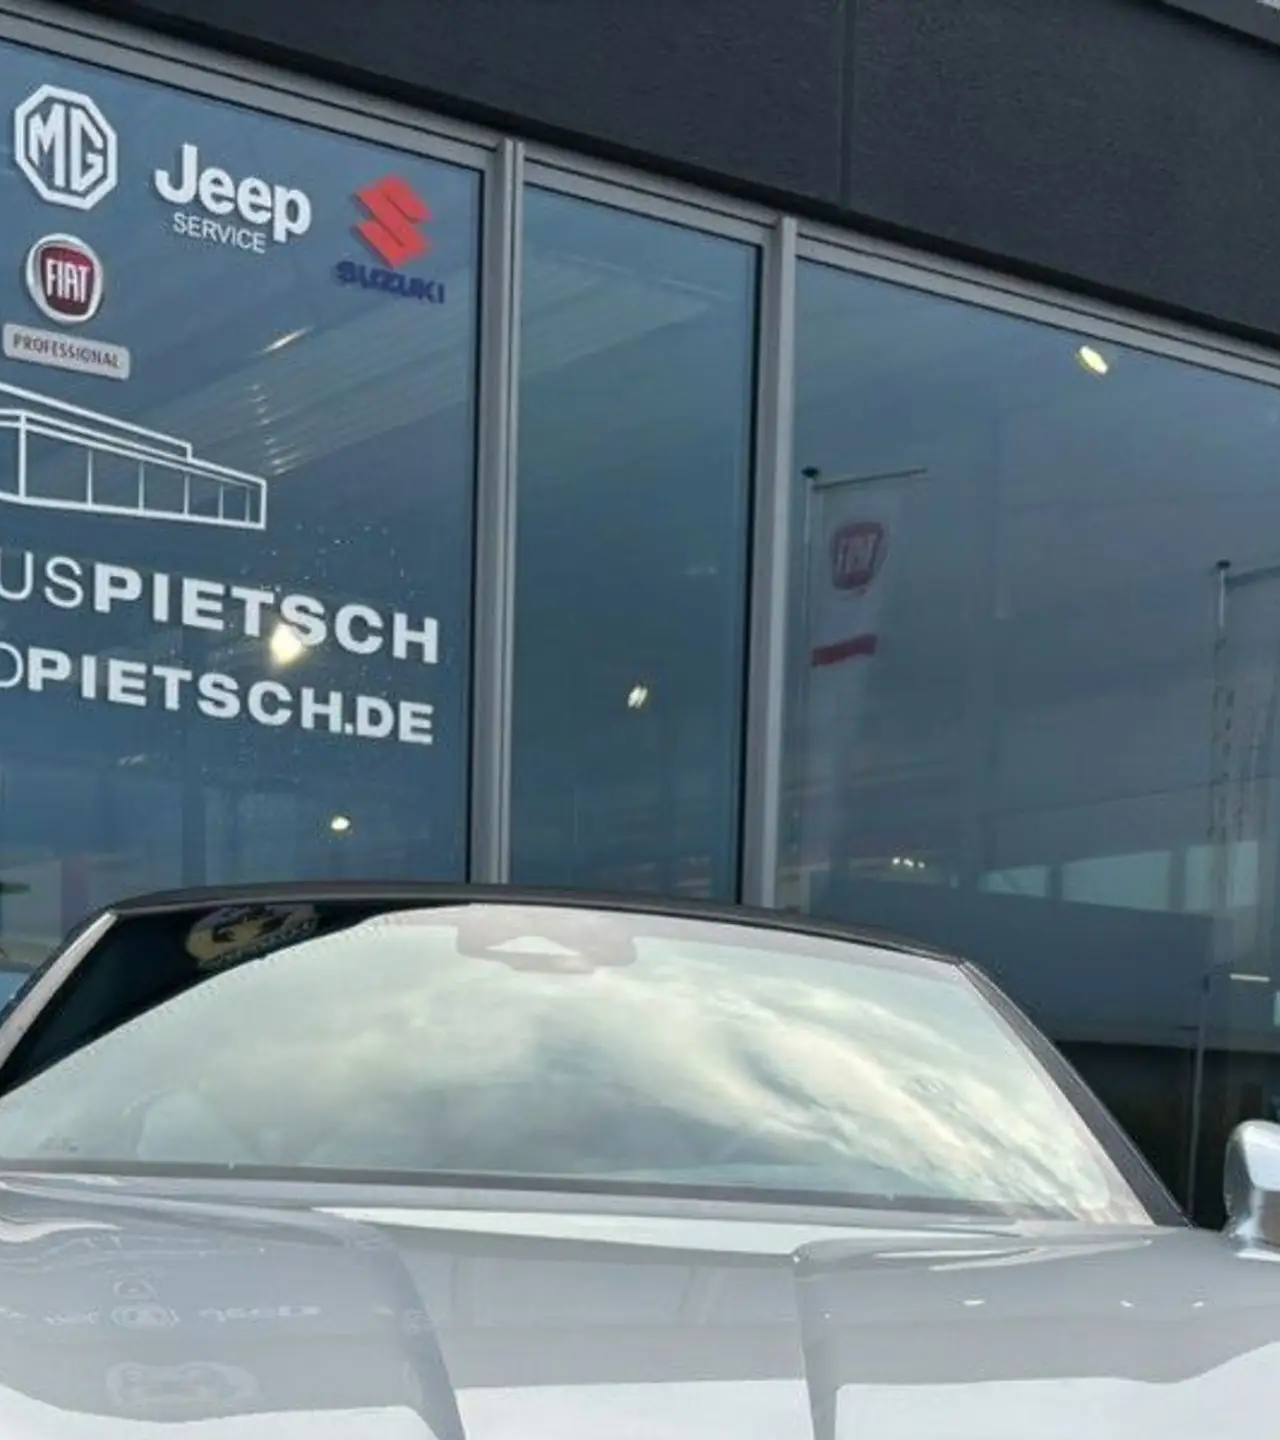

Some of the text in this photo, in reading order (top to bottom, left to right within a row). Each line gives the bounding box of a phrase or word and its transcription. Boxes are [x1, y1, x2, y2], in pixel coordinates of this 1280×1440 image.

[28, 102, 104, 194] MG
[154, 143, 313, 244] Jeep
[173, 211, 267, 254] SERVICE
[45, 257, 91, 304] FIAT
[335, 259, 445, 304] SUZUKI
[12, 331, 121, 370] PROFESSIONAL
